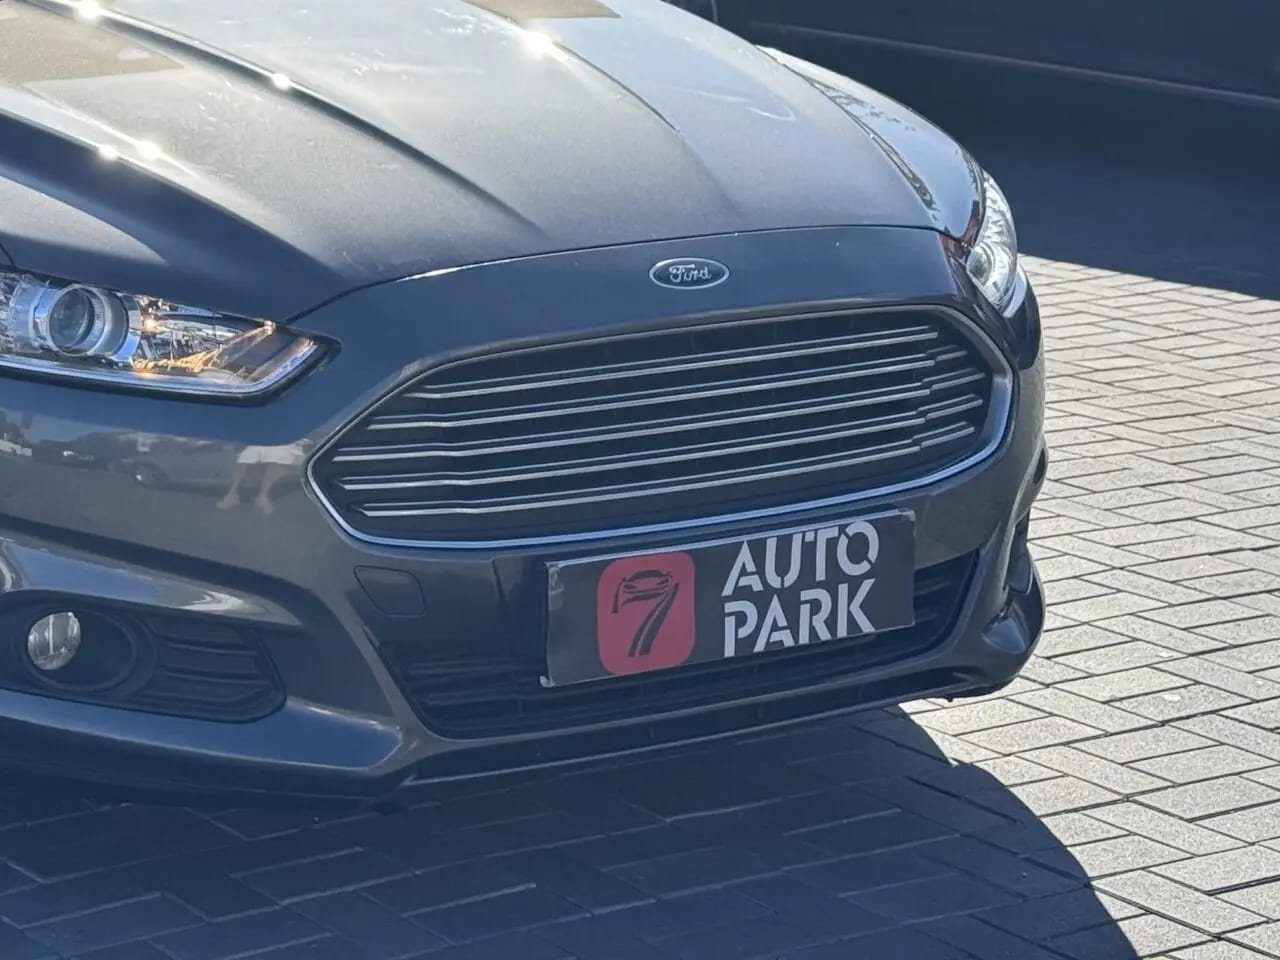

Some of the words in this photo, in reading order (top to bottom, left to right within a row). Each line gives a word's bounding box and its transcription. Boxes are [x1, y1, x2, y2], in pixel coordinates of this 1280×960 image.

[669, 263, 712, 282] Ford
[721, 520, 879, 596] AUTO
[724, 578, 875, 658] PARK
